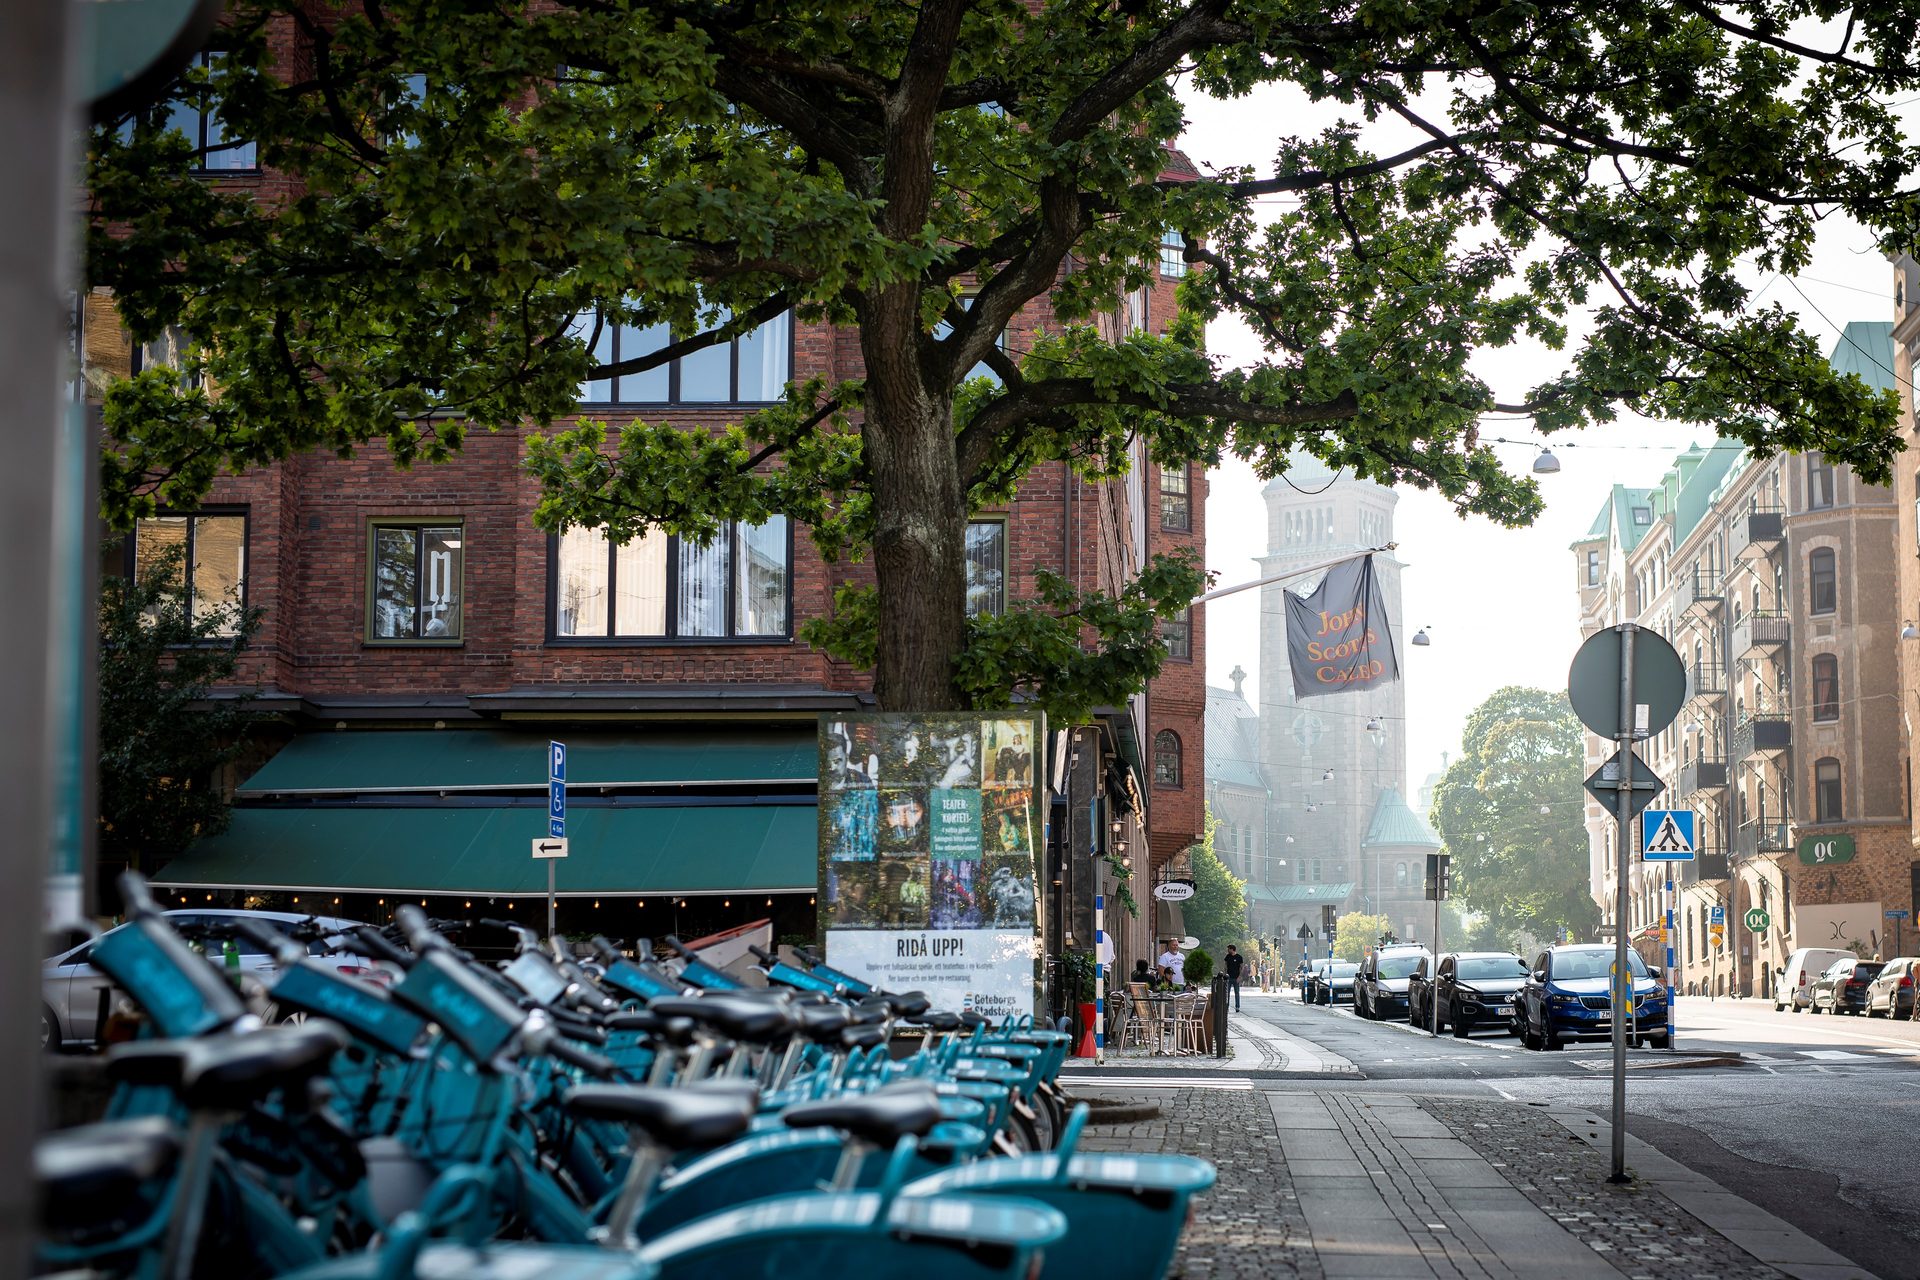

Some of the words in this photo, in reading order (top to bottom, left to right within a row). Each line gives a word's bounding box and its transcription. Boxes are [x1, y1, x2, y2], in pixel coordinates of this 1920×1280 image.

[554, 746, 563, 775] P
[1815, 840, 1837, 863] QC
[1714, 907, 1722, 917] P
[1749, 913, 1767, 928] QC
[897, 934, 927, 957] RIDÅ
[932, 938, 964, 957] UPP!
[974, 994, 1017, 1005] Göteborgs
[974, 1006, 1023, 1016] Stadsteater
